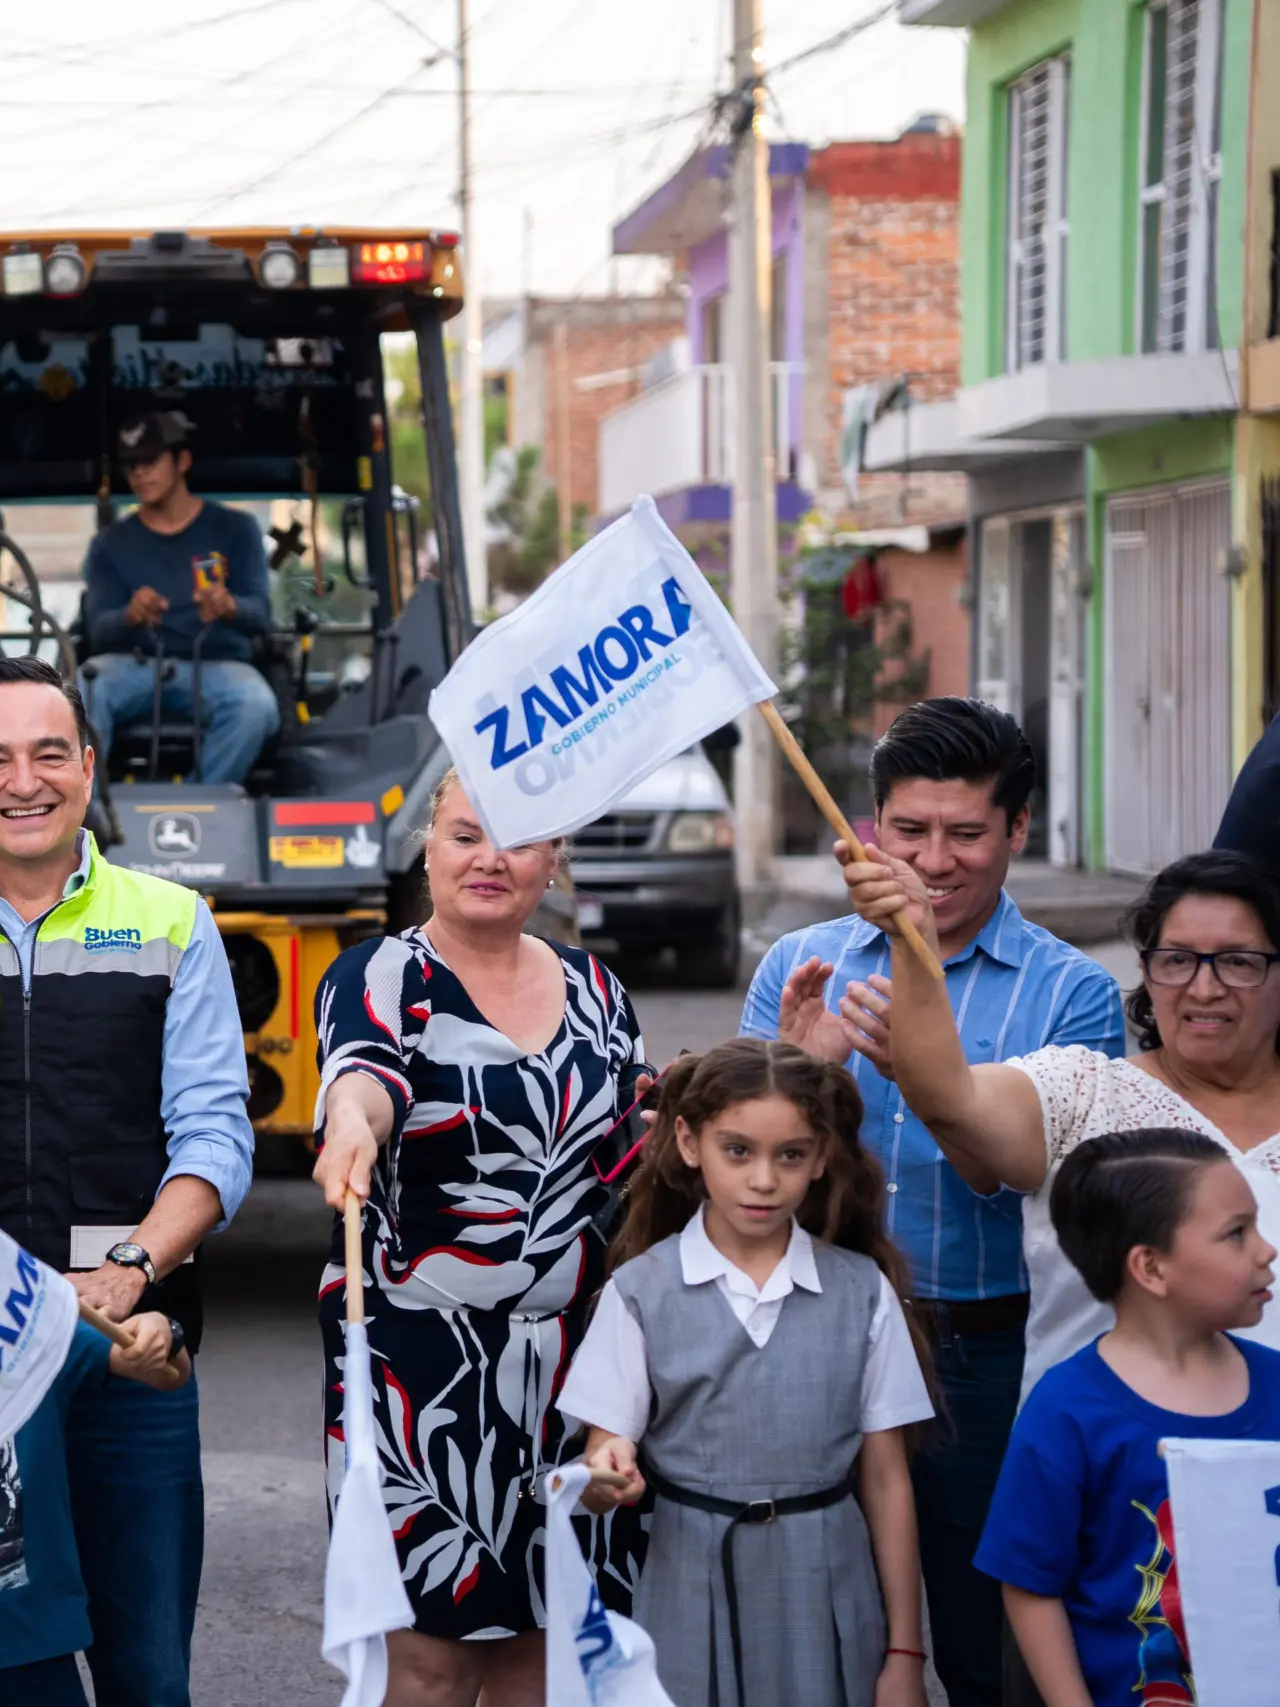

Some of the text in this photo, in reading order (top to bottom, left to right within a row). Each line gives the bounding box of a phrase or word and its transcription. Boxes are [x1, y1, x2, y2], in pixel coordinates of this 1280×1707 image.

[474, 576, 691, 770] ZAMORA
[551, 653, 682, 756] GOBIERNO MUNICIPAL
[84, 939, 142, 950] Gobierno
[85, 927, 141, 941] Buen
